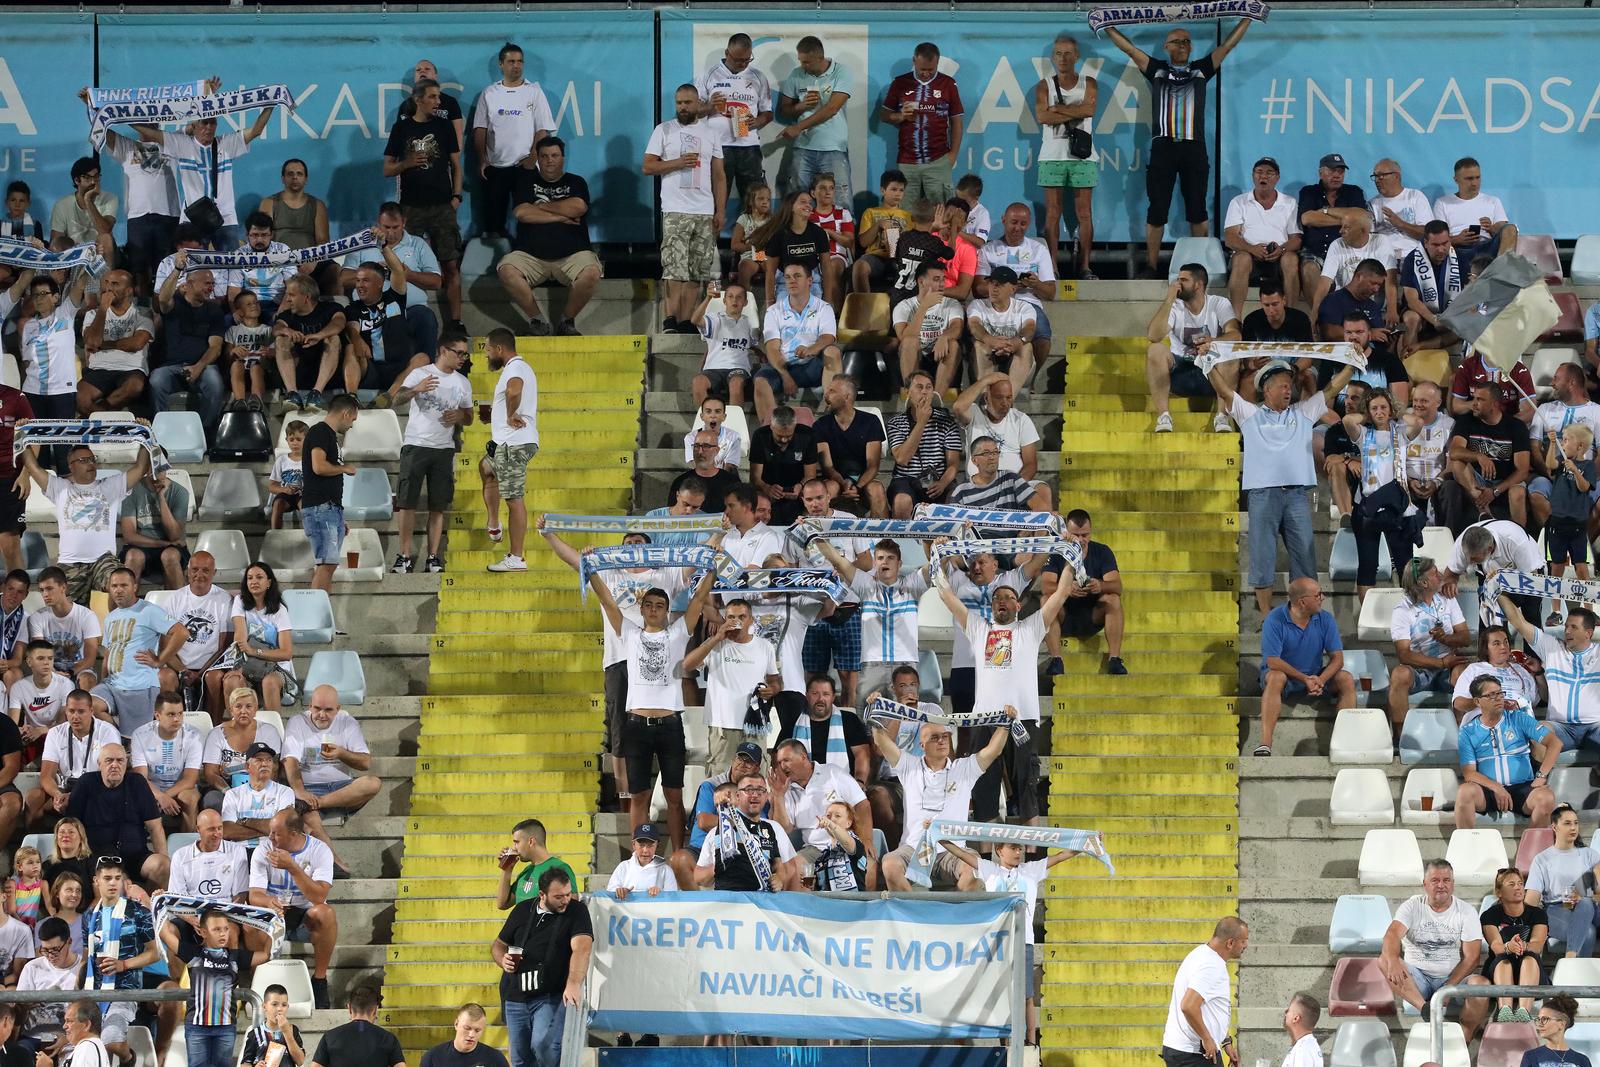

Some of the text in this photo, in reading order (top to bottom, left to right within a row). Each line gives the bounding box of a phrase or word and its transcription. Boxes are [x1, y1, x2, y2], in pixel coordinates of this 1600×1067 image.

[1103, 1, 1247, 22] ARMADA RIJEKA
[98, 84, 193, 102] HNK RIJEKA
[166, 94, 210, 103] PROTIV
[99, 86, 282, 124] ARMADA RIJEKA
[202, 109, 228, 118] FIUME
[204, 256, 272, 265] ARMADA
[301, 236, 359, 260] RIJEKA
[790, 247, 814, 255] adidas
[28, 426, 150, 438] RIJEKA
[932, 506, 1050, 524] RIJEKA
[642, 519, 722, 530] RIJEKA
[828, 520, 956, 532] RIJEKA
[1560, 594, 1596, 604] RIJEKA
[33, 696, 50, 705] NIKE
[874, 698, 928, 722] RMADA
[940, 824, 1062, 843] HNK RIJEKA
[608, 914, 1010, 972] KREPAT MA NE MOLAT
[700, 968, 922, 1014] NAVIJAČI RUBEŠI
